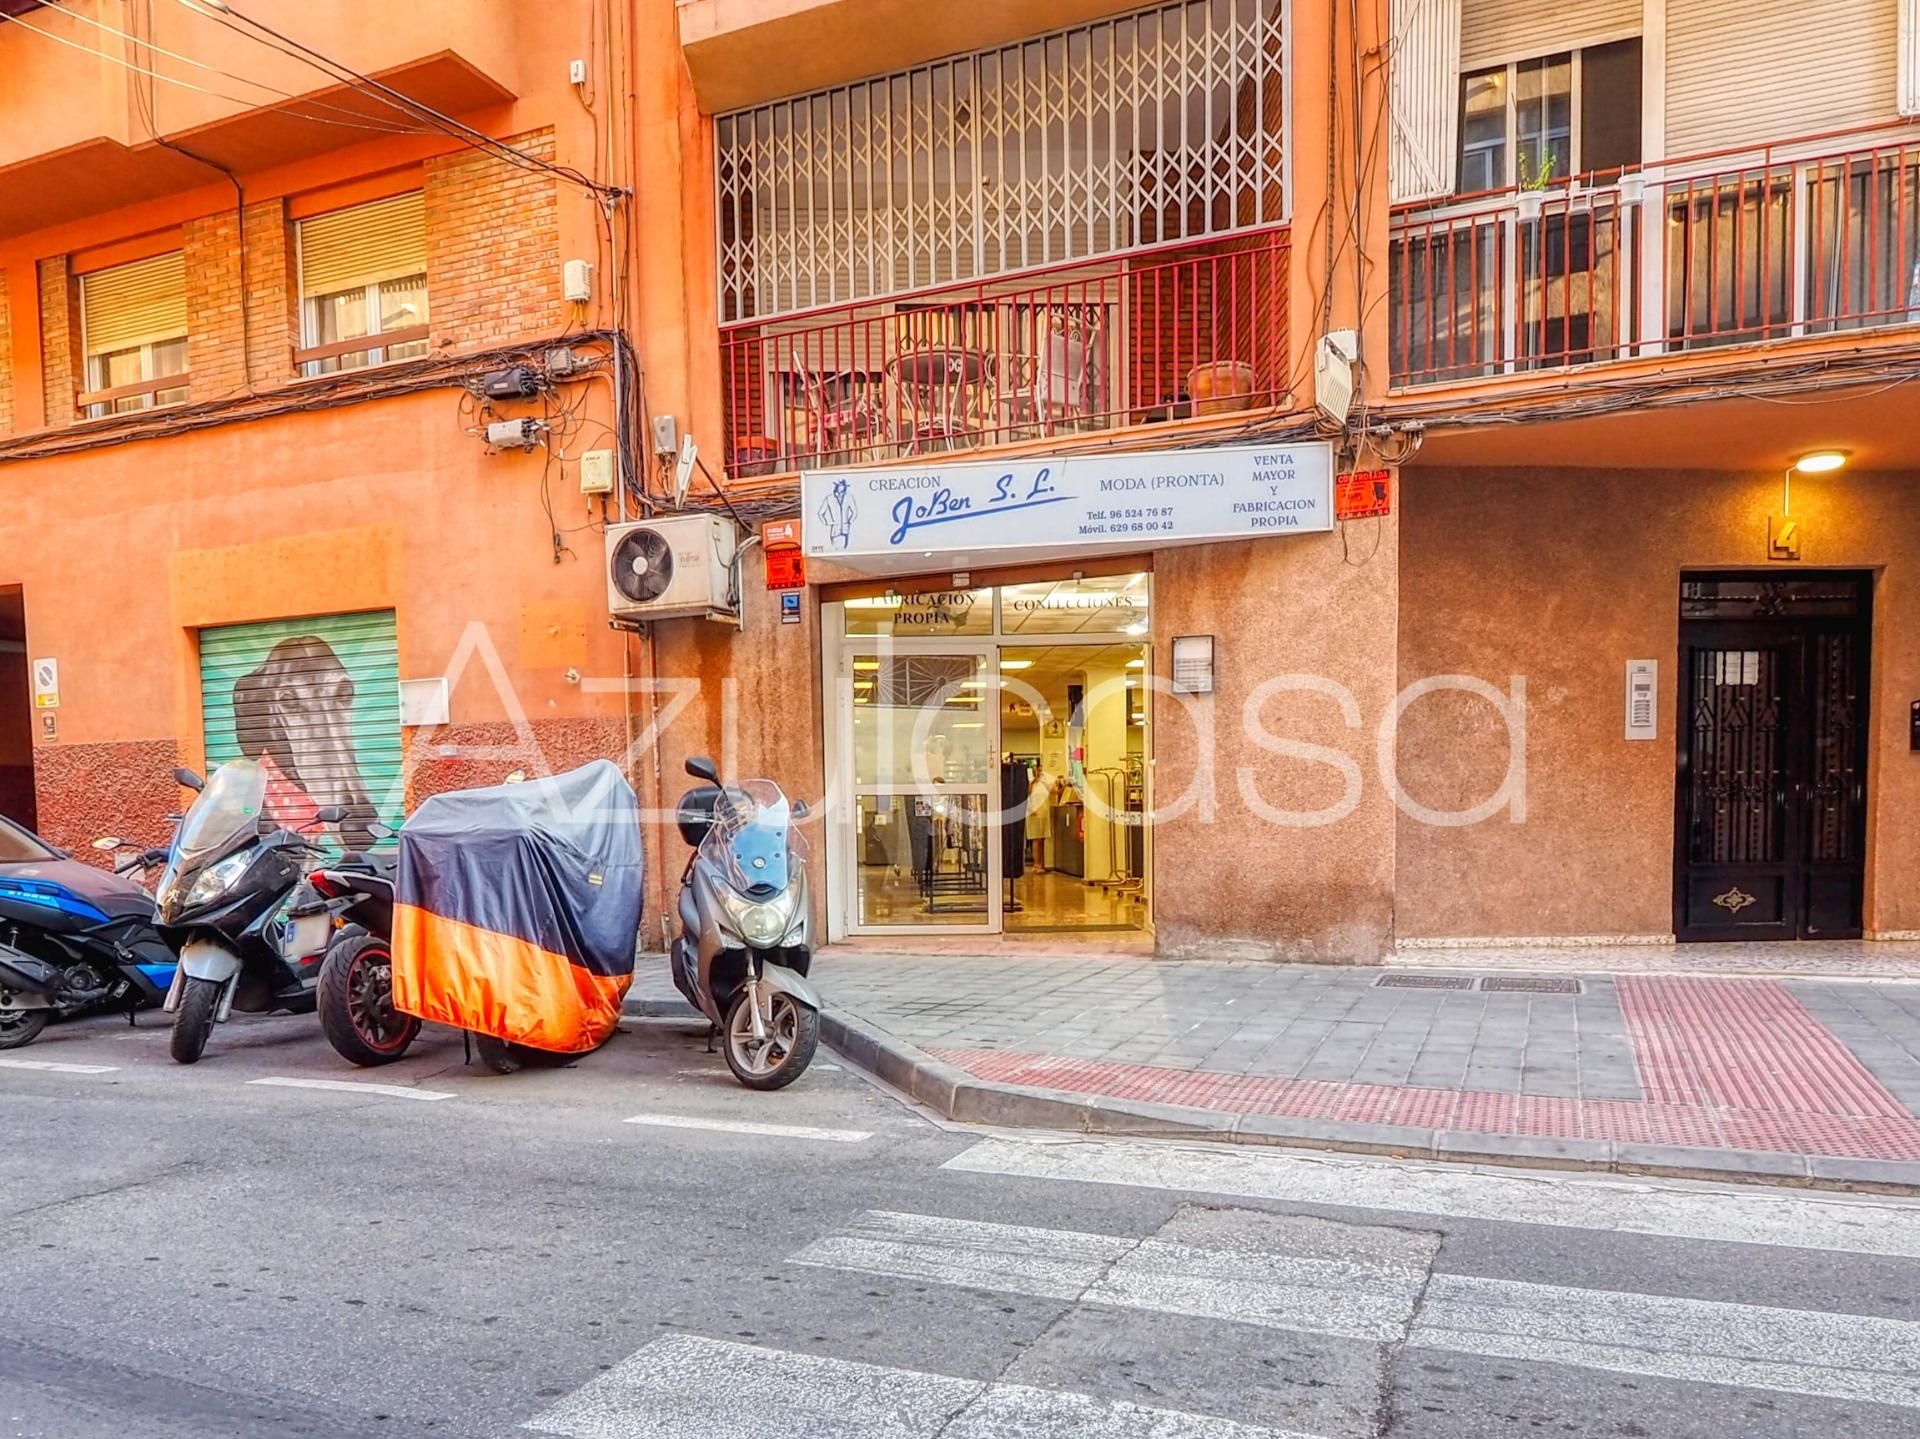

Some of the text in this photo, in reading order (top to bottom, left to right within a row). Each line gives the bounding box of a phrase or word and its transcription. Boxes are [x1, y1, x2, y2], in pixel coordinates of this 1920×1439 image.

[1254, 454, 1294, 466] VENTA
[1100, 473, 1224, 491] MODA (PRONTA)
[1252, 469, 1296, 482] MAYOR
[988, 474, 1016, 503] S.
[1026, 468, 1055, 501] L.
[1270, 485, 1278, 496] Y
[1233, 499, 1316, 513] FABRICACION
[1087, 507, 1174, 520] Telf. 96 524 76 87
[1079, 521, 1174, 534] Móvil. 629 68 00 42
[1251, 515, 1298, 527] PROPIA
[1774, 522, 1798, 553] 4
[894, 612, 950, 624] PROPIA
